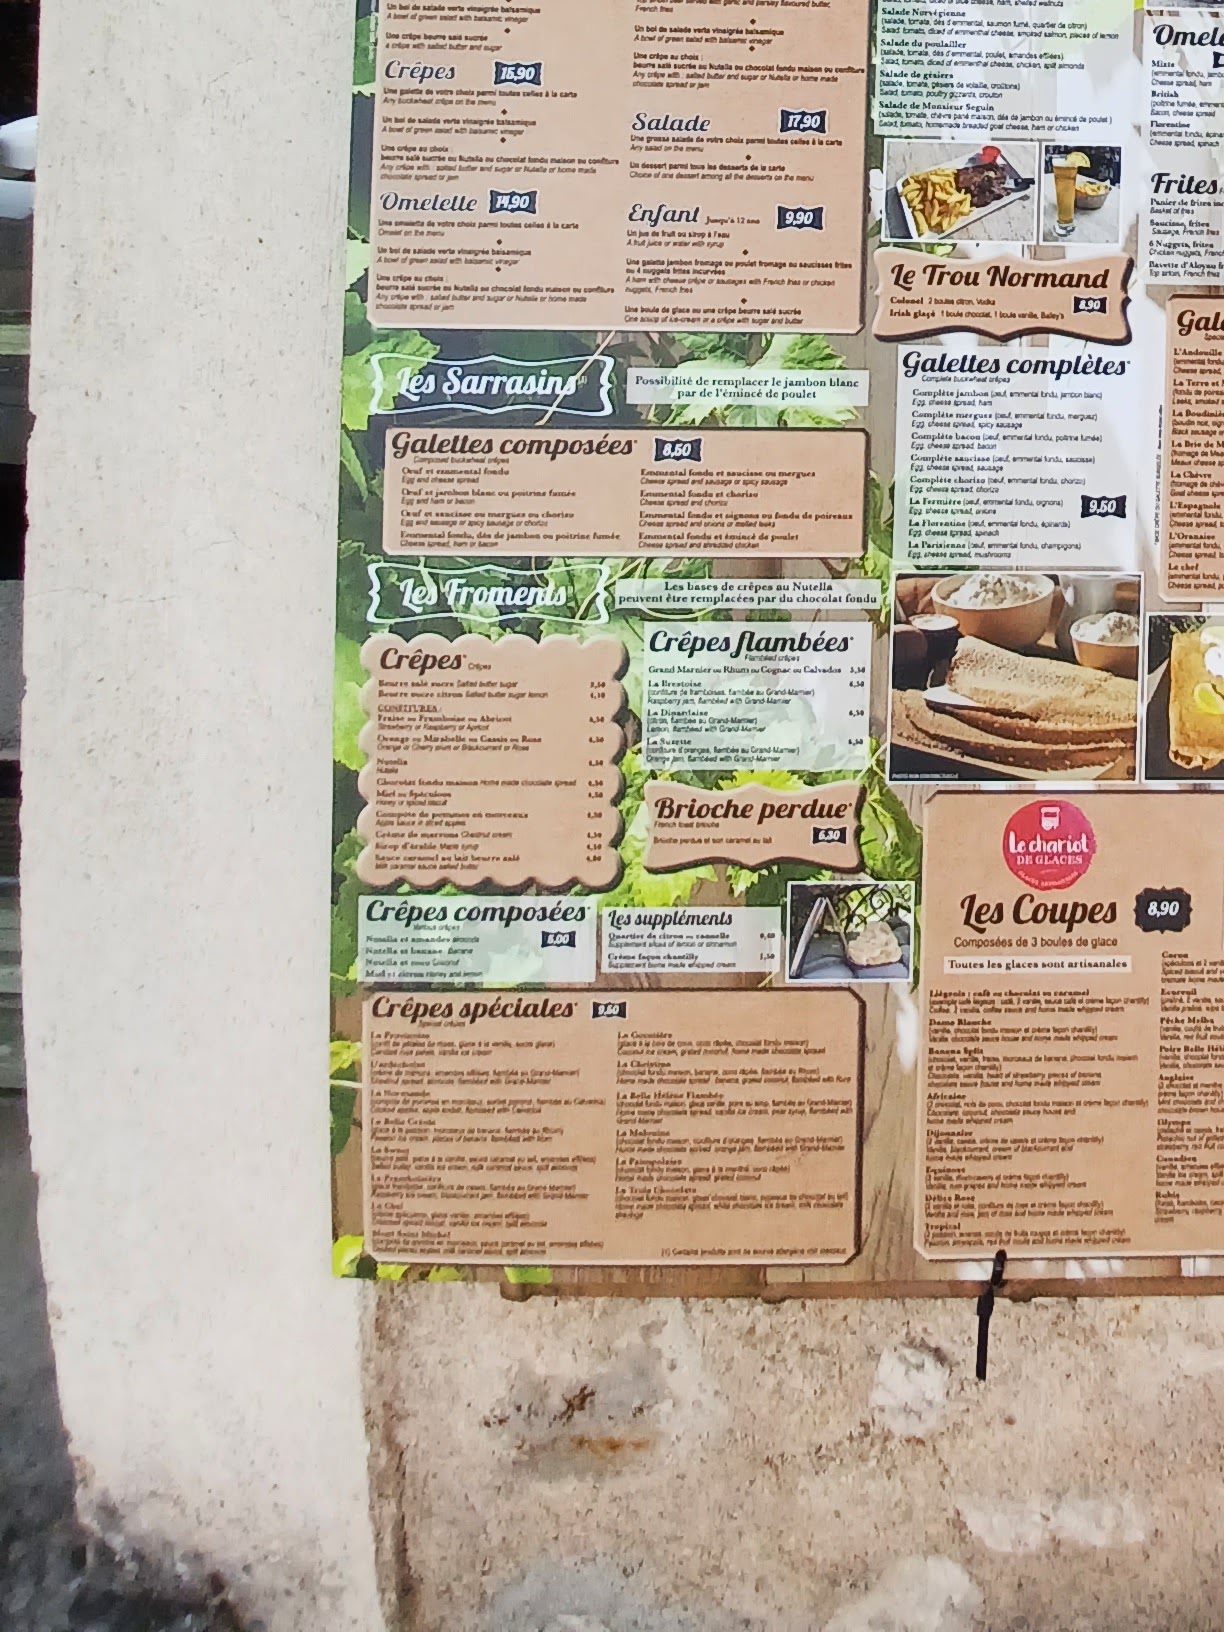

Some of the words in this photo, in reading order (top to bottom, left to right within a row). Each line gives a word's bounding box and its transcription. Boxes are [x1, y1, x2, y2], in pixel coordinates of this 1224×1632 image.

[385, 60, 455, 84] Crêpes
[632, 113, 710, 131] Salade
[788, 115, 821, 128] 17,90
[1151, 173, 1218, 195] Frites
[381, 192, 477, 211] Omelette
[629, 204, 700, 227] Enfant
[785, 212, 813, 225] 9,90
[891, 264, 915, 291] Le
[923, 264, 980, 286] Trou
[986, 266, 1109, 288] Normand
[903, 351, 1000, 377] Galettes
[1006, 354, 1127, 381] complètes
[397, 367, 435, 401] Les
[443, 367, 576, 395] Sarrasins
[636, 376, 692, 386] Possibilité
[696, 377, 709, 386] de
[712, 377, 769, 389] remplacer
[772, 377, 781, 386] le
[784, 376, 826, 388] jambon
[830, 377, 858, 387] blanc
[677, 390, 696, 400] par
[700, 389, 712, 398] de
[715, 388, 762, 398] l'émincé
[766, 390, 778, 399] de
[781, 389, 816, 400] poulet
[392, 432, 493, 459] Galettes
[500, 433, 633, 461] composées
[400, 578, 438, 613] Les
[446, 578, 567, 606] Froments
[664, 582, 684, 591] Les
[688, 582, 718, 591] bases
[721, 582, 734, 591] de
[737, 582, 773, 594] crêpes
[776, 583, 789, 591] au
[793, 582, 833, 591] Nutella
[619, 595, 663, 605] peuvent
[666, 593, 687, 603] être
[691, 593, 754, 605] remplacées
[757, 595, 776, 606] par
[779, 593, 793, 603] du
[797, 594, 842, 603] chocolat
[846, 594, 876, 603] fondu
[650, 630, 730, 658] Crêpes
[380, 648, 462, 676] Crêpes
[655, 797, 753, 818] Brioche
[757, 799, 847, 824] perdue
[1009, 831, 1027, 853] Le
[1029, 833, 1089, 854] chariot
[1017, 855, 1033, 865] DE
[1036, 855, 1082, 865] GLACES
[366, 900, 448, 928] Crêpes
[608, 910, 631, 930] Les
[635, 910, 732, 930] suppléments
[960, 894, 1004, 934] Les
[1013, 894, 1117, 933] Coupes
[1148, 901, 1180, 918] 8,90
[954, 937, 1013, 948] Composées
[1016, 938, 1028, 947] de
[1031, 938, 1037, 947] 3
[1041, 937, 1072, 947] boules
[1076, 938, 1088, 947] de
[1091, 937, 1117, 949] glace
[948, 960, 984, 969] Toutes
[987, 960, 1002, 969] les
[1005, 960, 1038, 970] glaces
[1068, 960, 1127, 968] artisanales
[372, 996, 454, 1023] Crêpes
